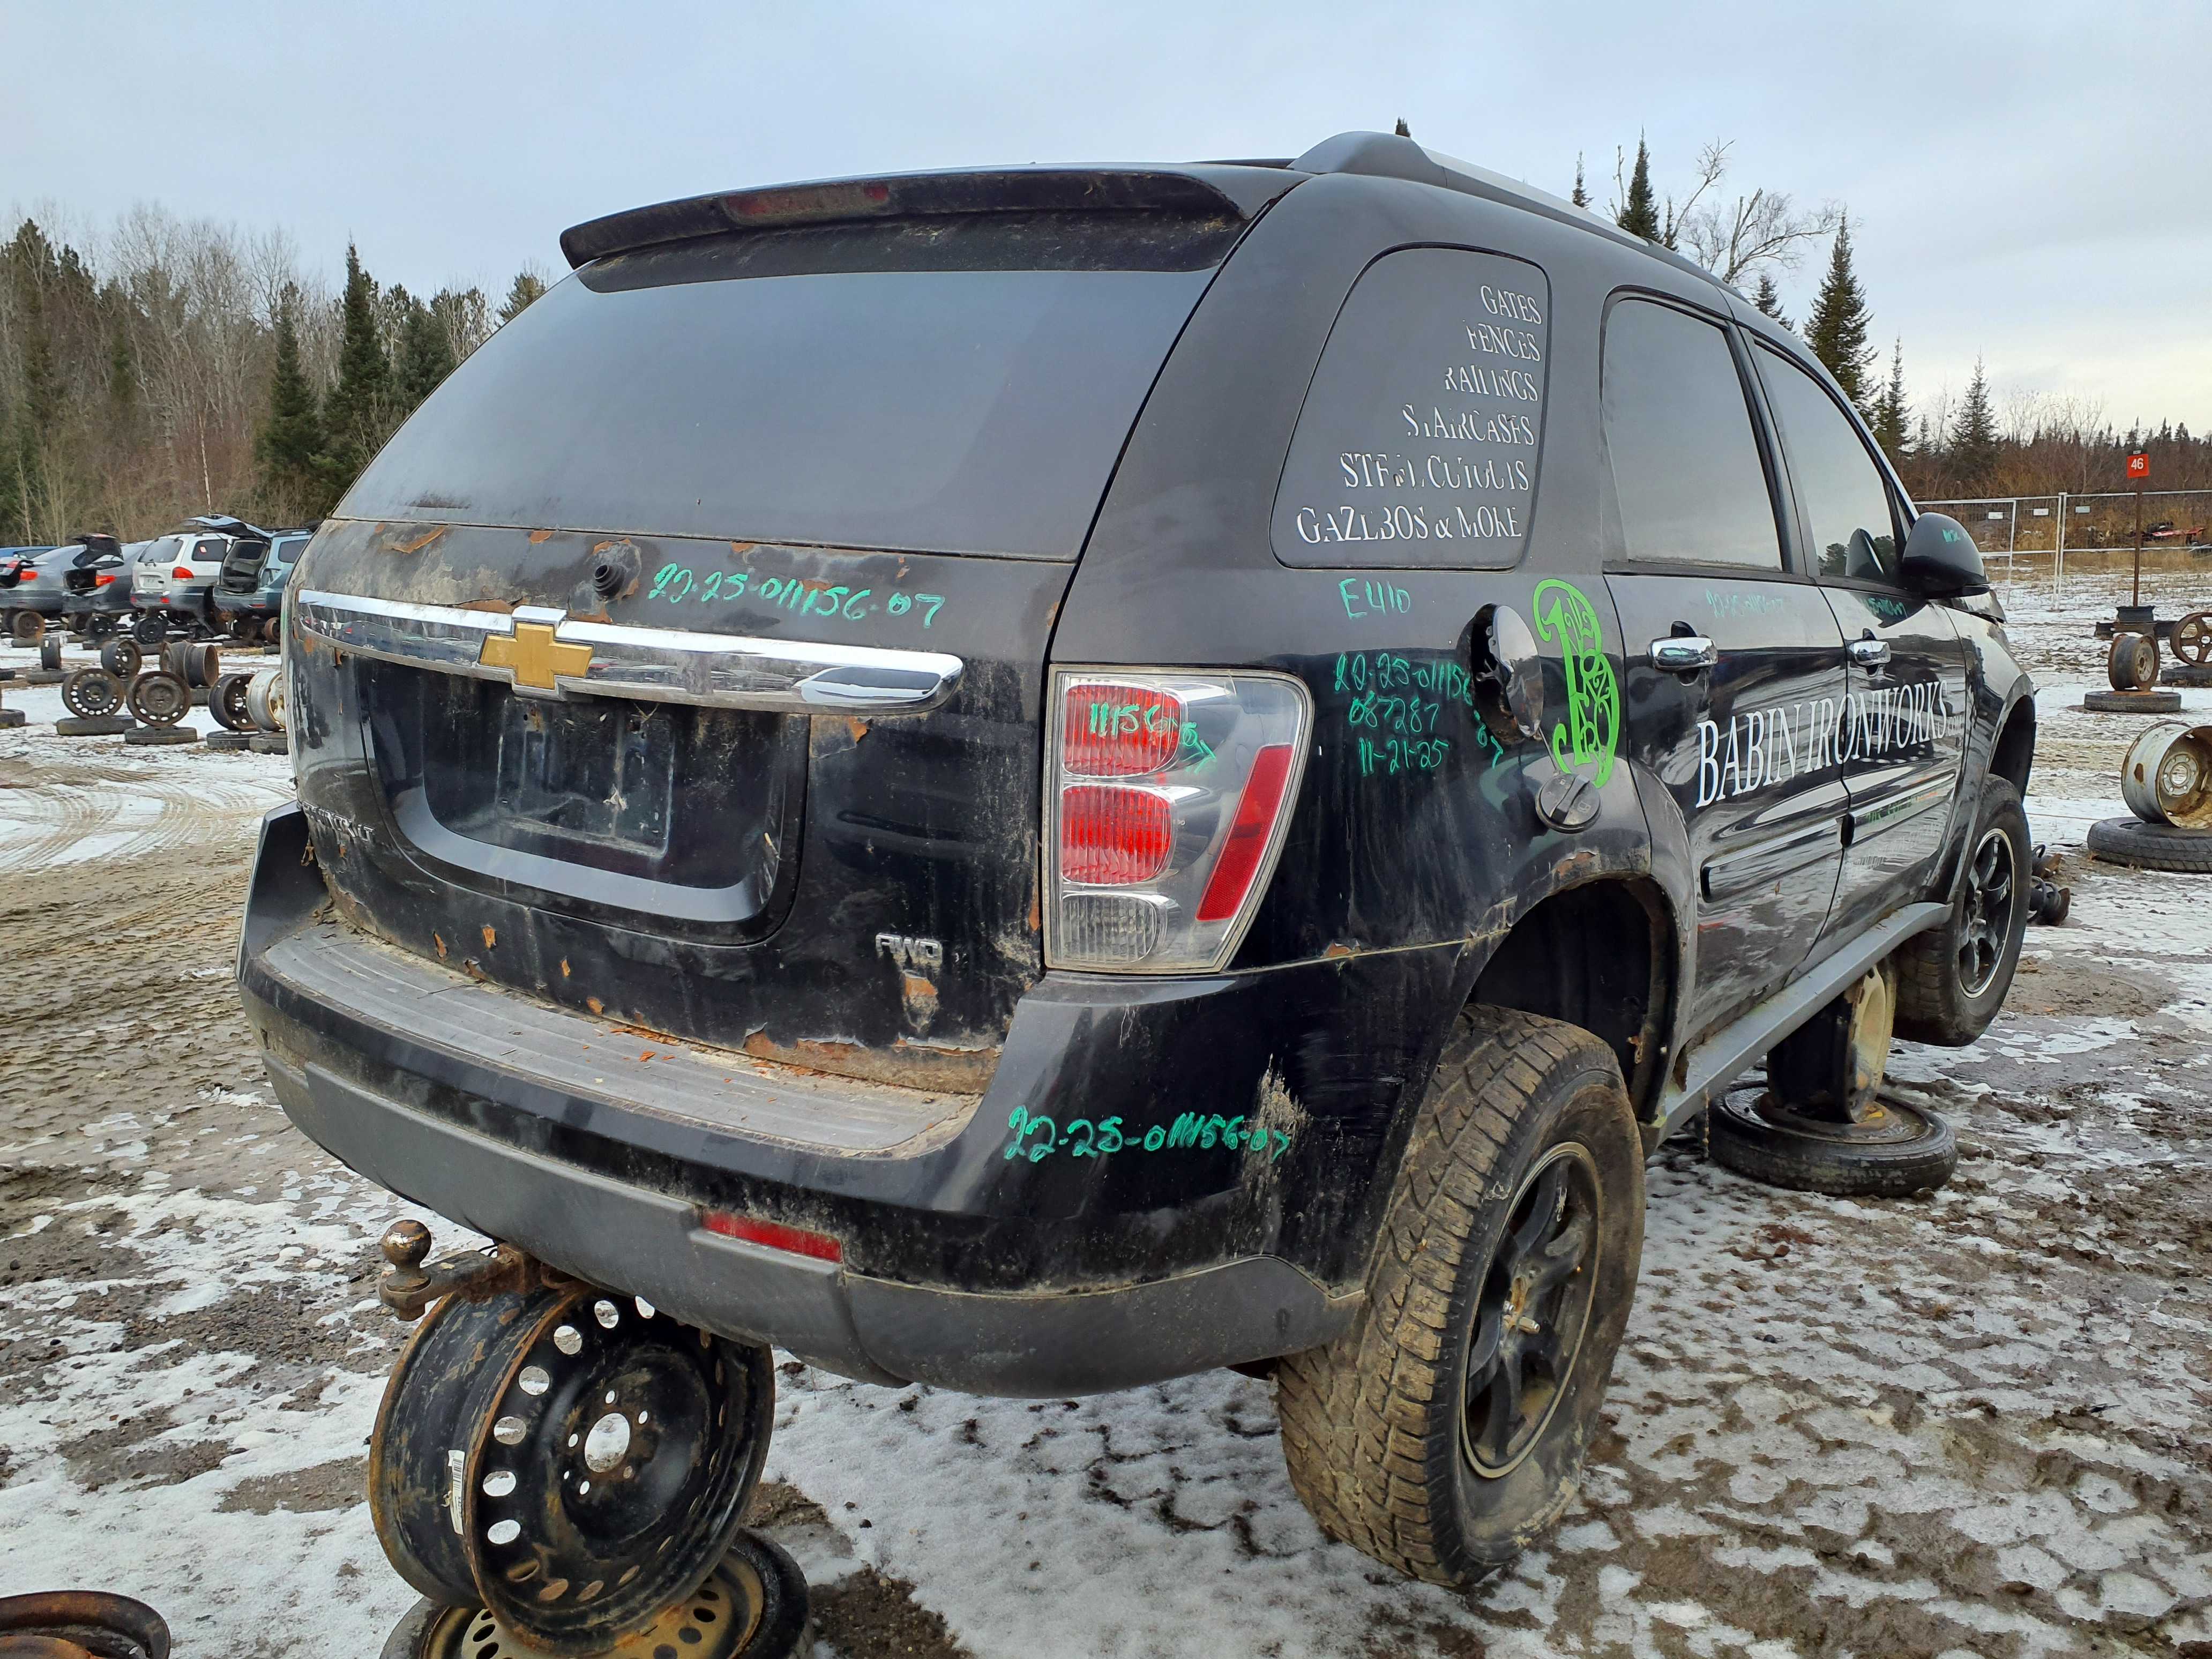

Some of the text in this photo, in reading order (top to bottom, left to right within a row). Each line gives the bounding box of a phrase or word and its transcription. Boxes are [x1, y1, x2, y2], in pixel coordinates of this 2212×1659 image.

[1479, 285, 1542, 325] GATES
[2131, 458, 2144, 470] 46
[1435, 517, 1453, 539] &
[1695, 704, 1801, 808] BABIN
